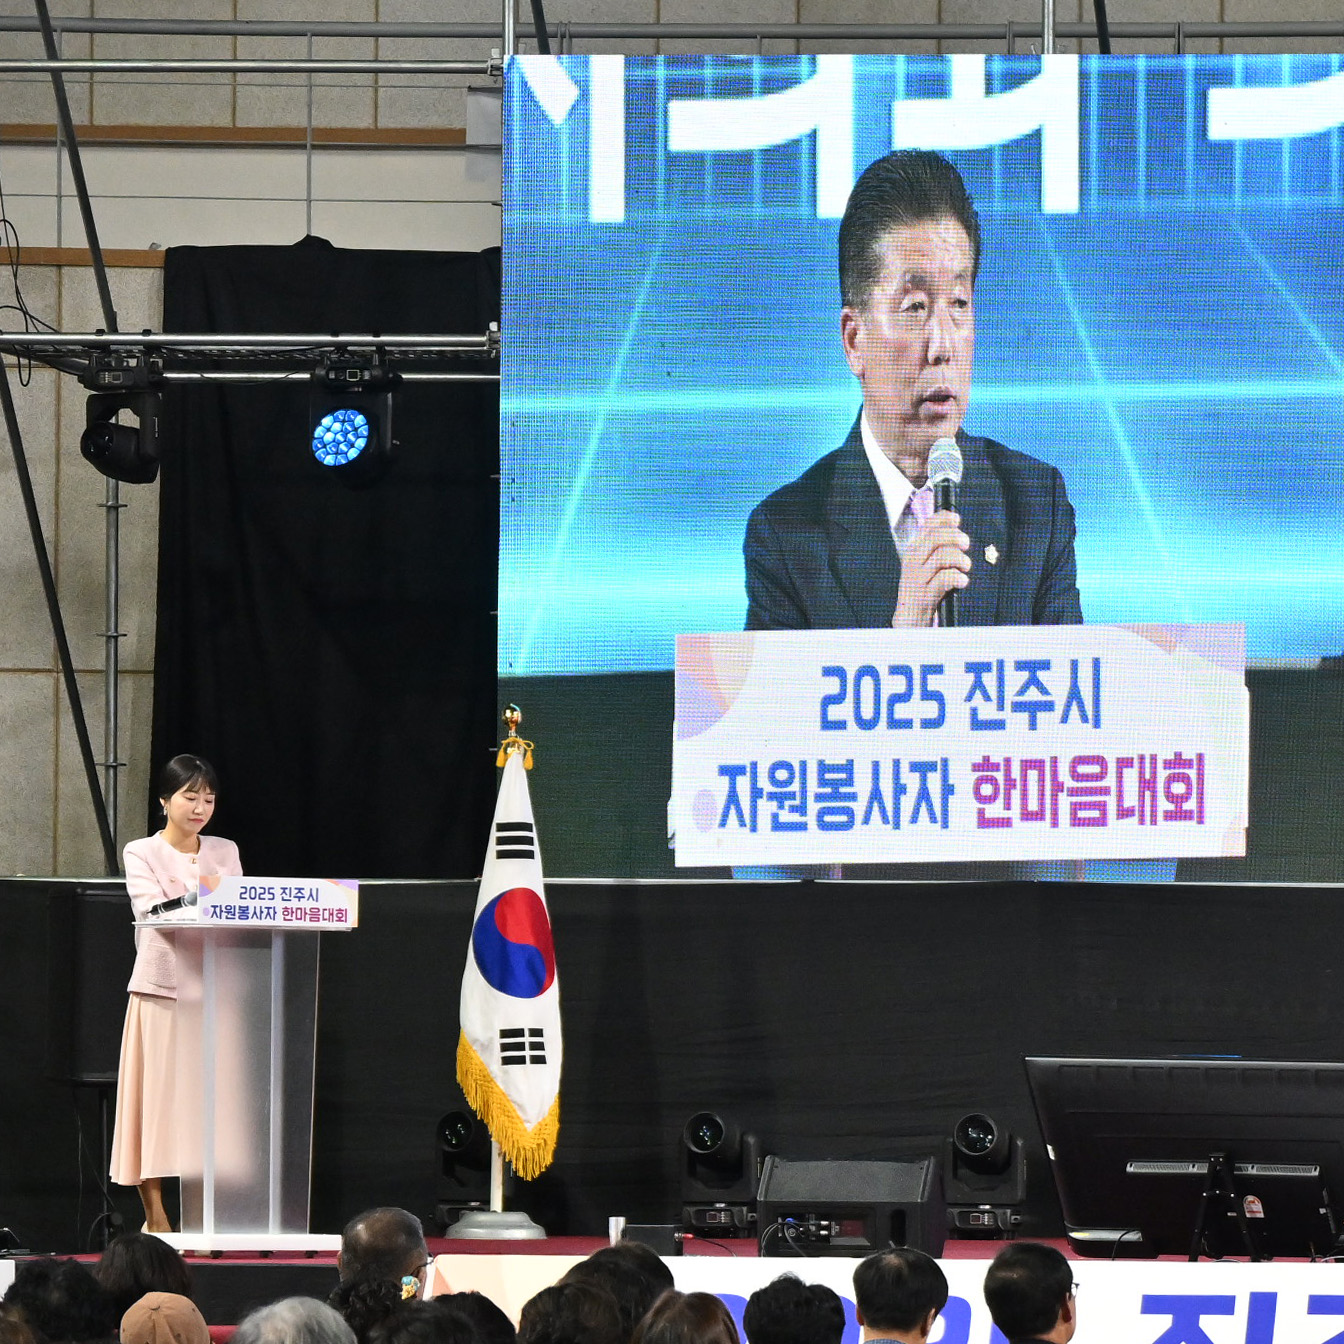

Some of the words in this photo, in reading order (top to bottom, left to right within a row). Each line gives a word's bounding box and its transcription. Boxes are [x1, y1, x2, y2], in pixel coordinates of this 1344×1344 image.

[820, 663, 946, 732] 2025
[964, 659, 1102, 732] 진주시
[717, 758, 955, 833] 자원봉사자
[972, 753, 1205, 829] 한마음대회
[210, 905, 277, 921] 자원봉사자
[282, 906, 348, 923] 한마음대회
[239, 886, 276, 901] 2025
[280, 887, 320, 902] 진주시
